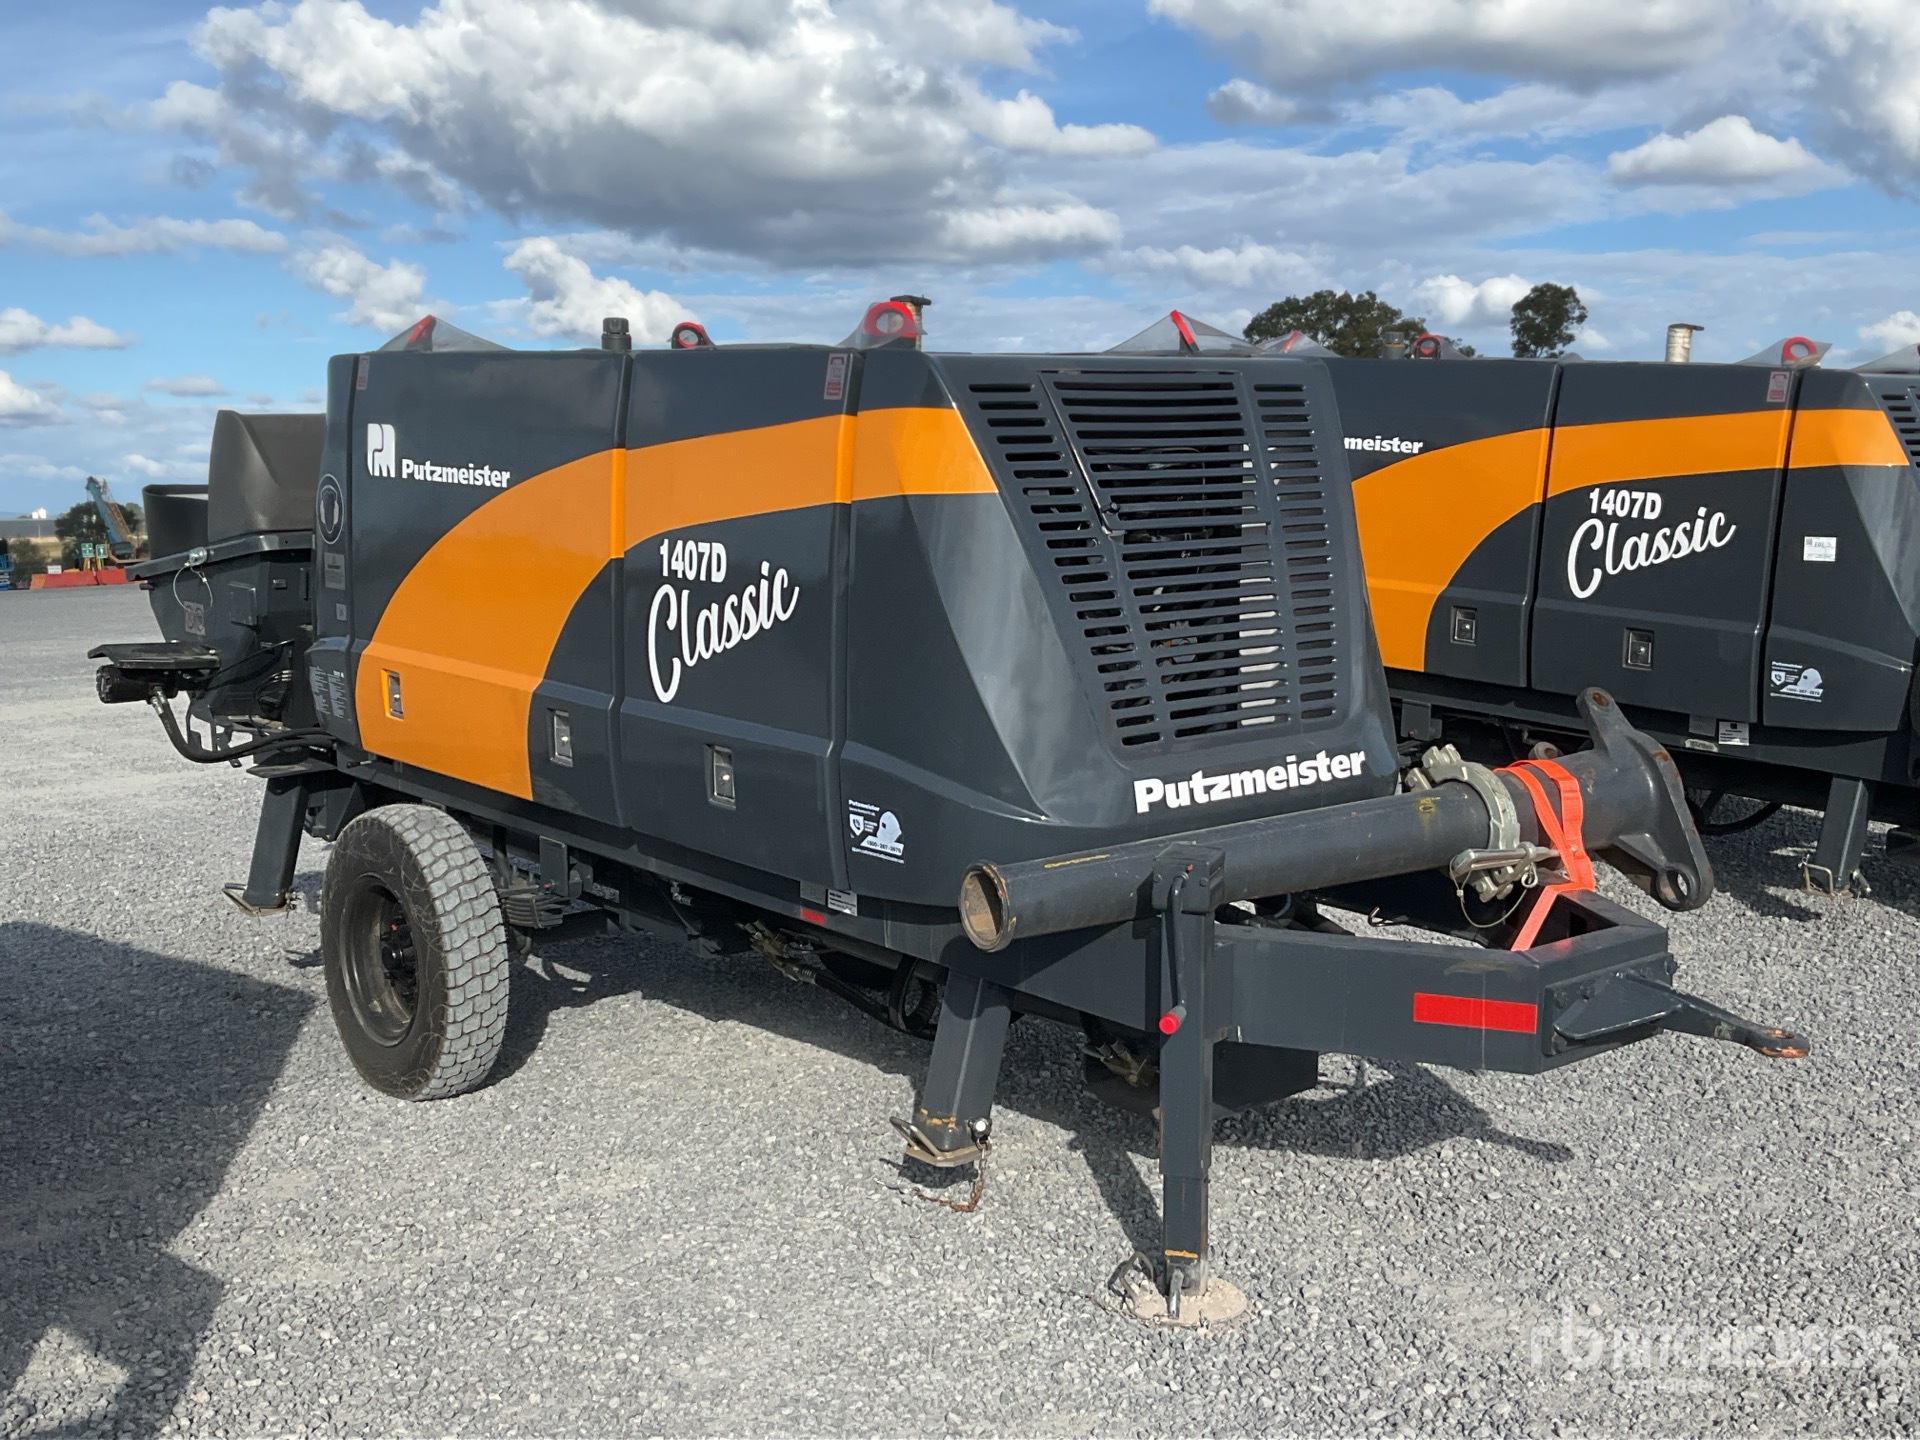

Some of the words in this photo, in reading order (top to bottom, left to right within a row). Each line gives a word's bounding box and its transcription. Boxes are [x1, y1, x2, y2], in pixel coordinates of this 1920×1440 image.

[401, 458, 511, 488] Putzmeister
[1589, 487, 1662, 520] 1407D
[659, 538, 727, 583] 1407D
[1567, 506, 1737, 599] Classic
[647, 560, 800, 703] Classic
[1133, 750, 1366, 814] Putzmeister
